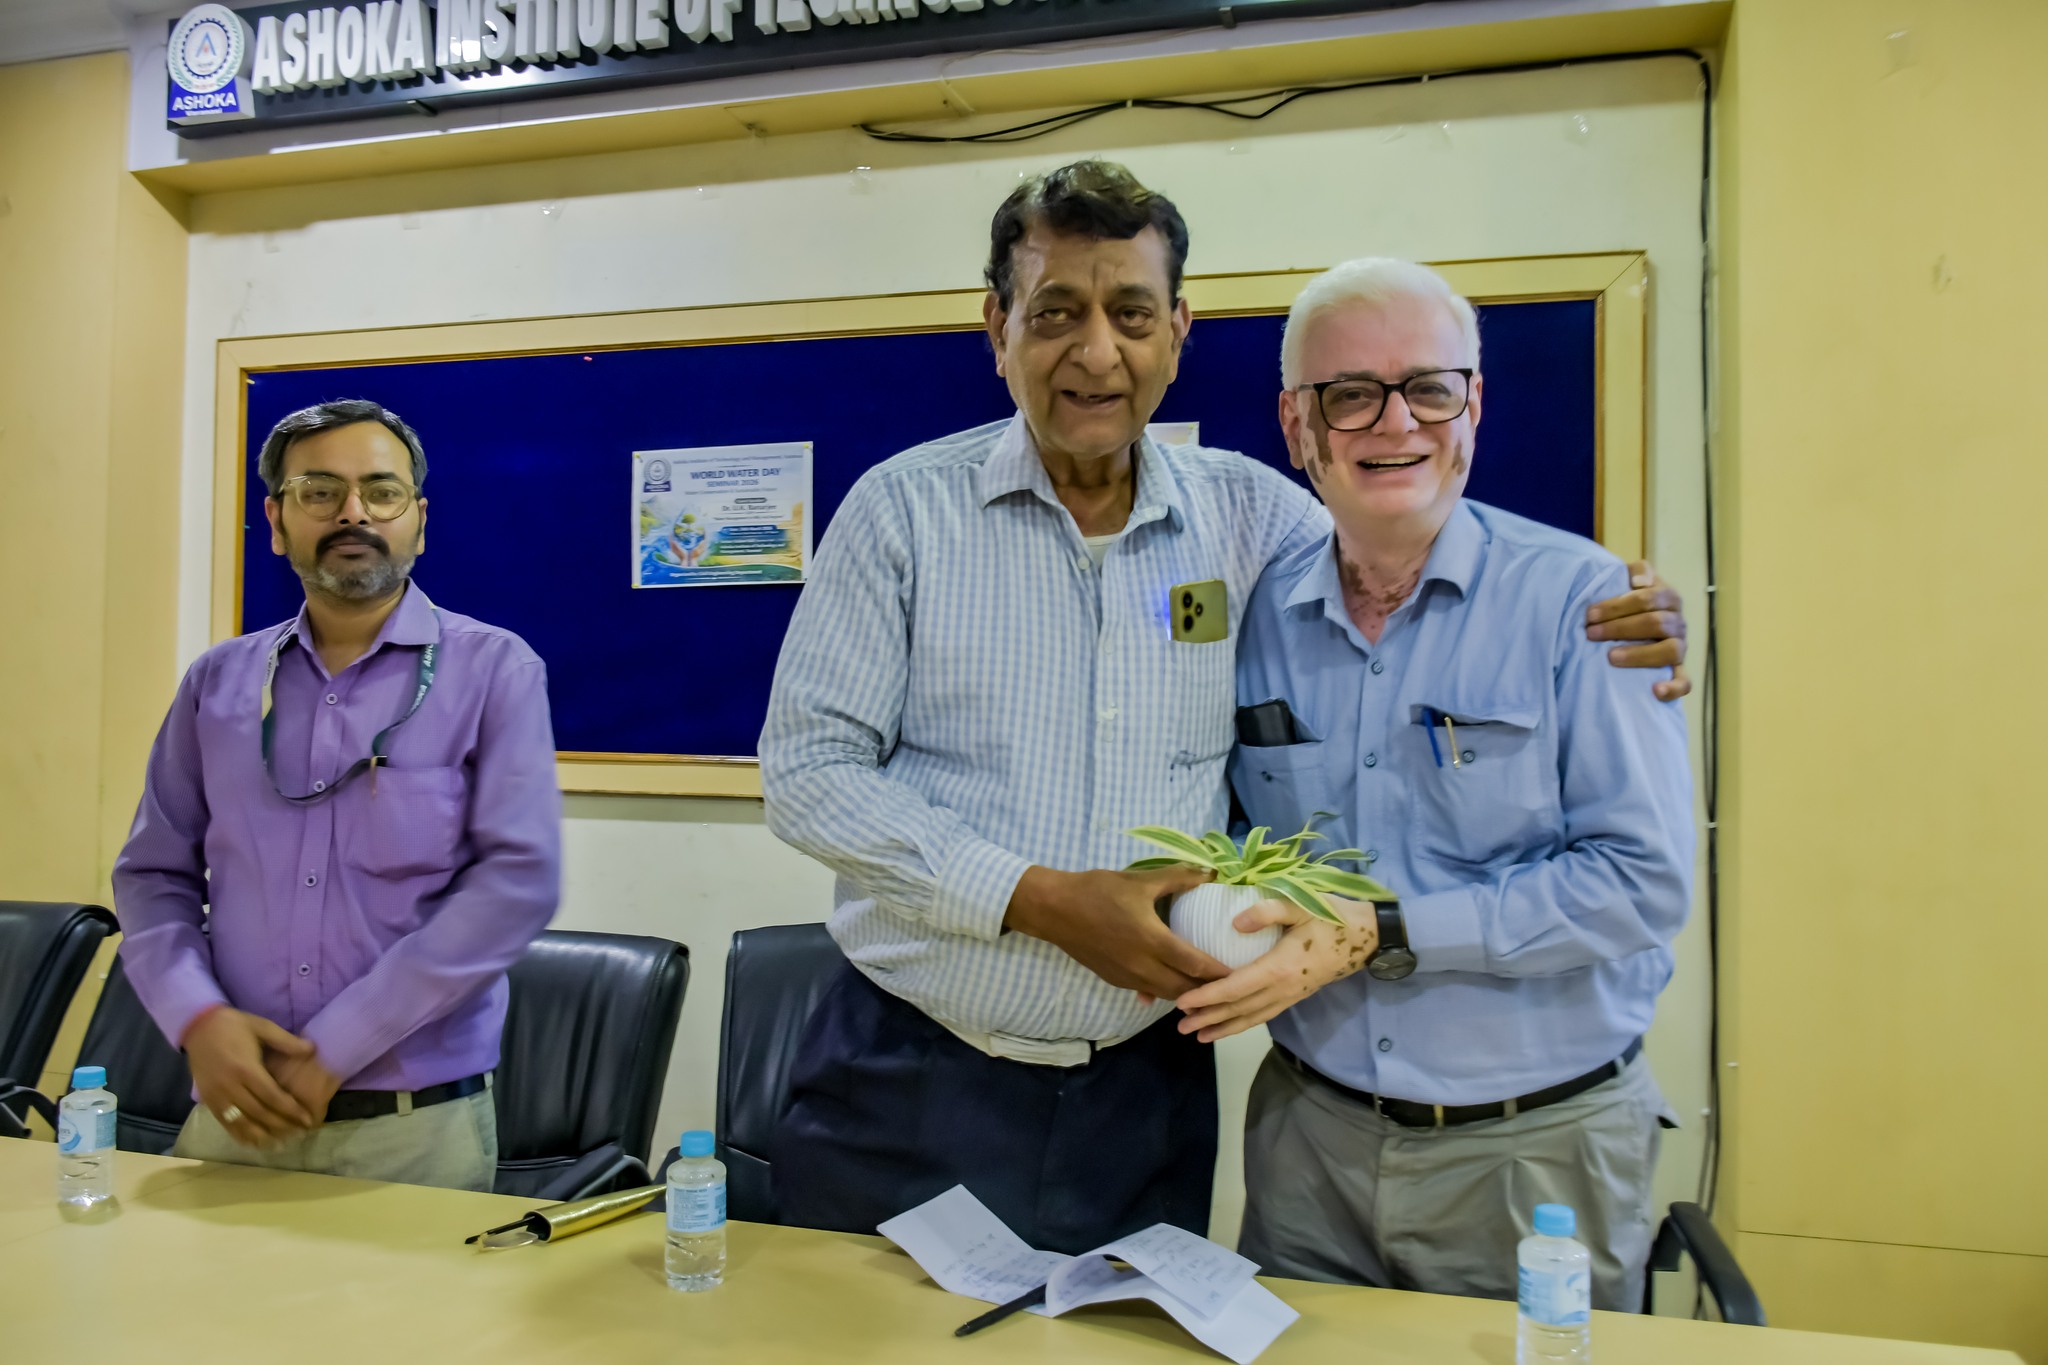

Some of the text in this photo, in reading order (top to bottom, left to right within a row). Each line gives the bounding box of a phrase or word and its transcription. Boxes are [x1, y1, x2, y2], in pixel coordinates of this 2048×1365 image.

[251, 0, 428, 93] ASHOKA
[172, 92, 237, 111] ASHOKA
[690, 467, 782, 480] WORLD WATER DAY
[706, 480, 739, 488] SEMINAR
